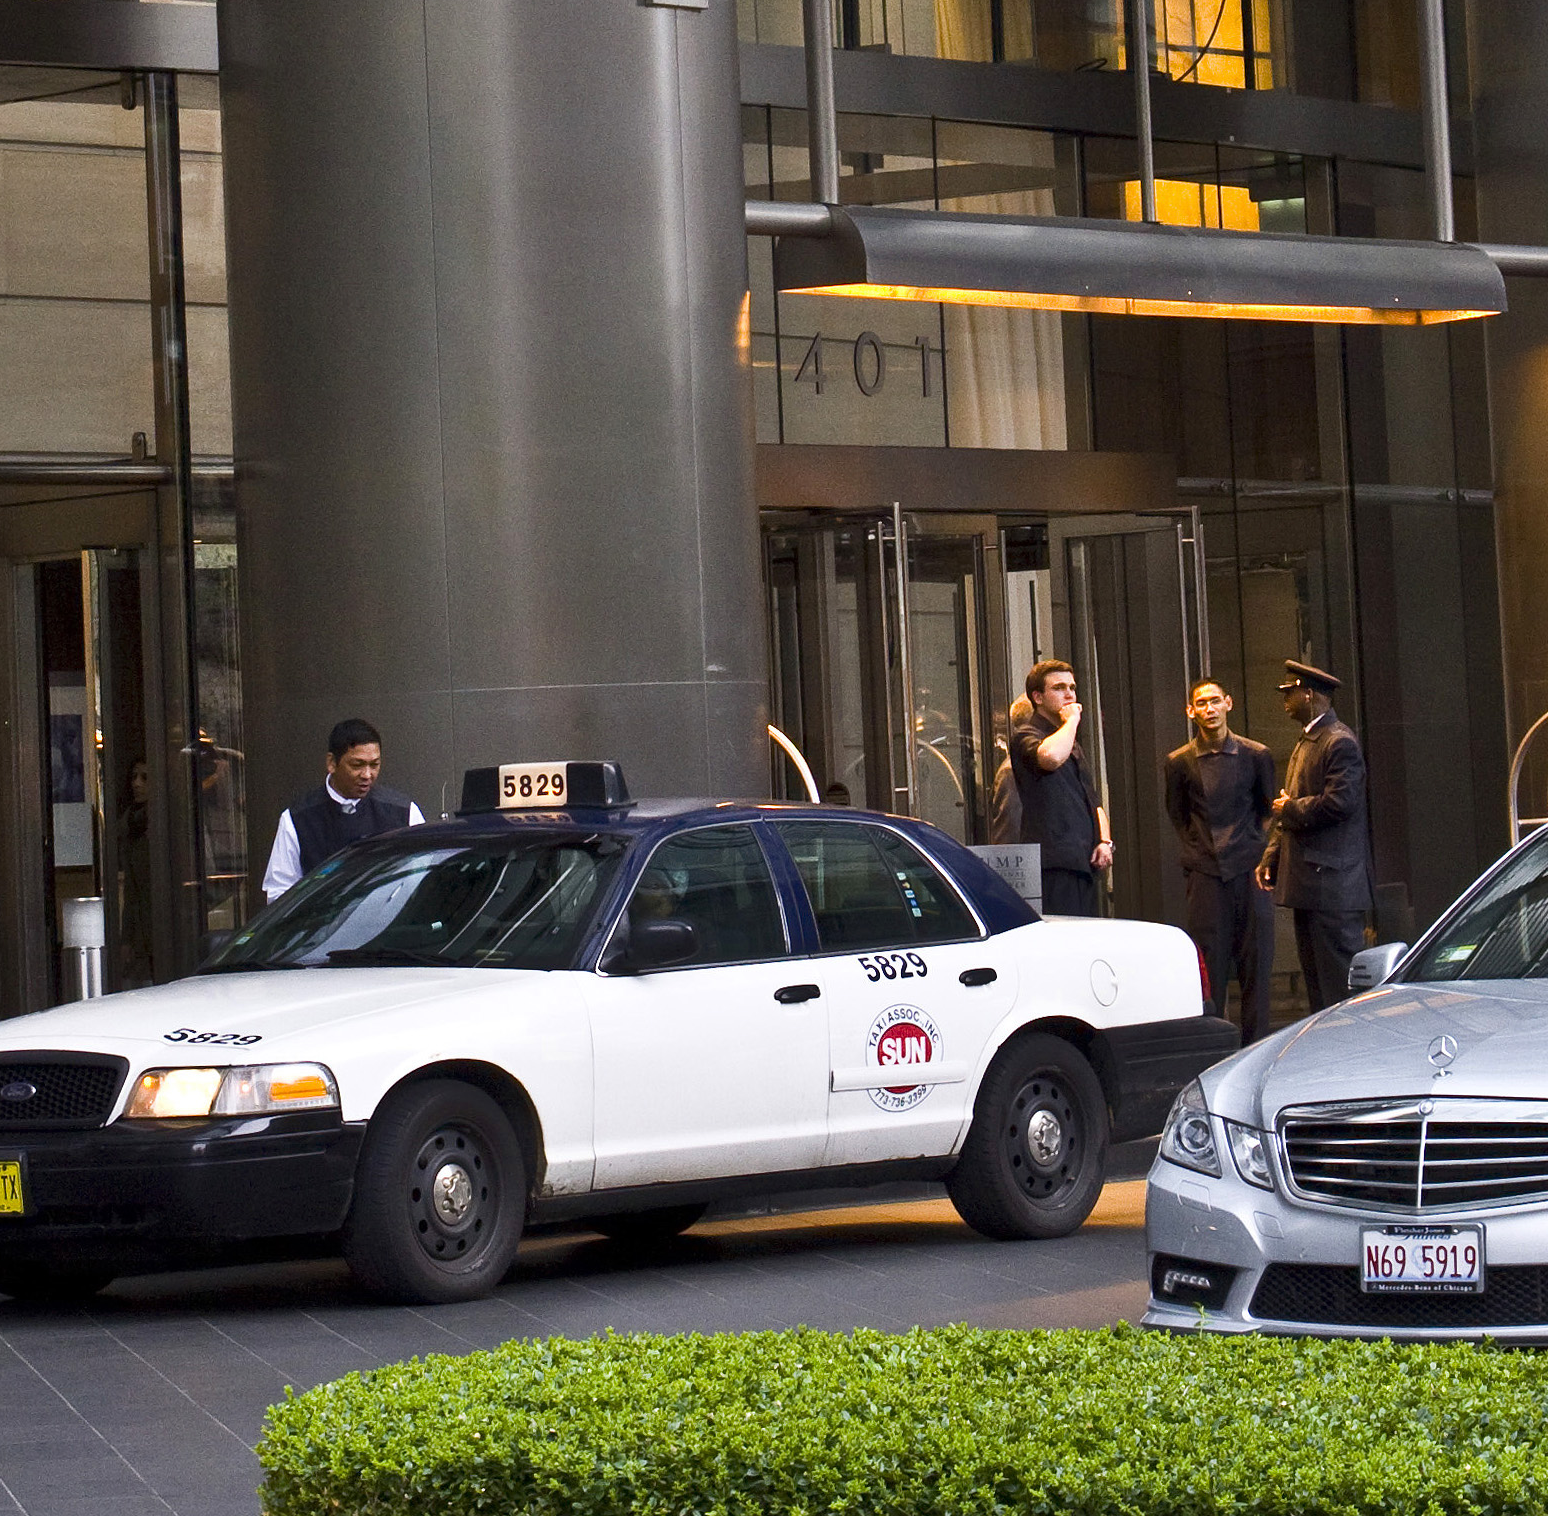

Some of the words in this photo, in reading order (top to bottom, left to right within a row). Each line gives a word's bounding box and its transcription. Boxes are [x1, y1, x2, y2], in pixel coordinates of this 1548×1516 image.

[793, 331, 931, 398] 401
[503, 773, 564, 798] 5829
[857, 952, 928, 983] 5829
[163, 1027, 263, 1045] 5829
[868, 1018, 887, 1047] TAXI
[882, 1036, 927, 1066] SUN
[1, 1175, 18, 1200] TX
[1367, 1245, 1406, 1278] N69
[1422, 1245, 1476, 1279] 5919
[1443, 1284, 1473, 1292] Chicago
